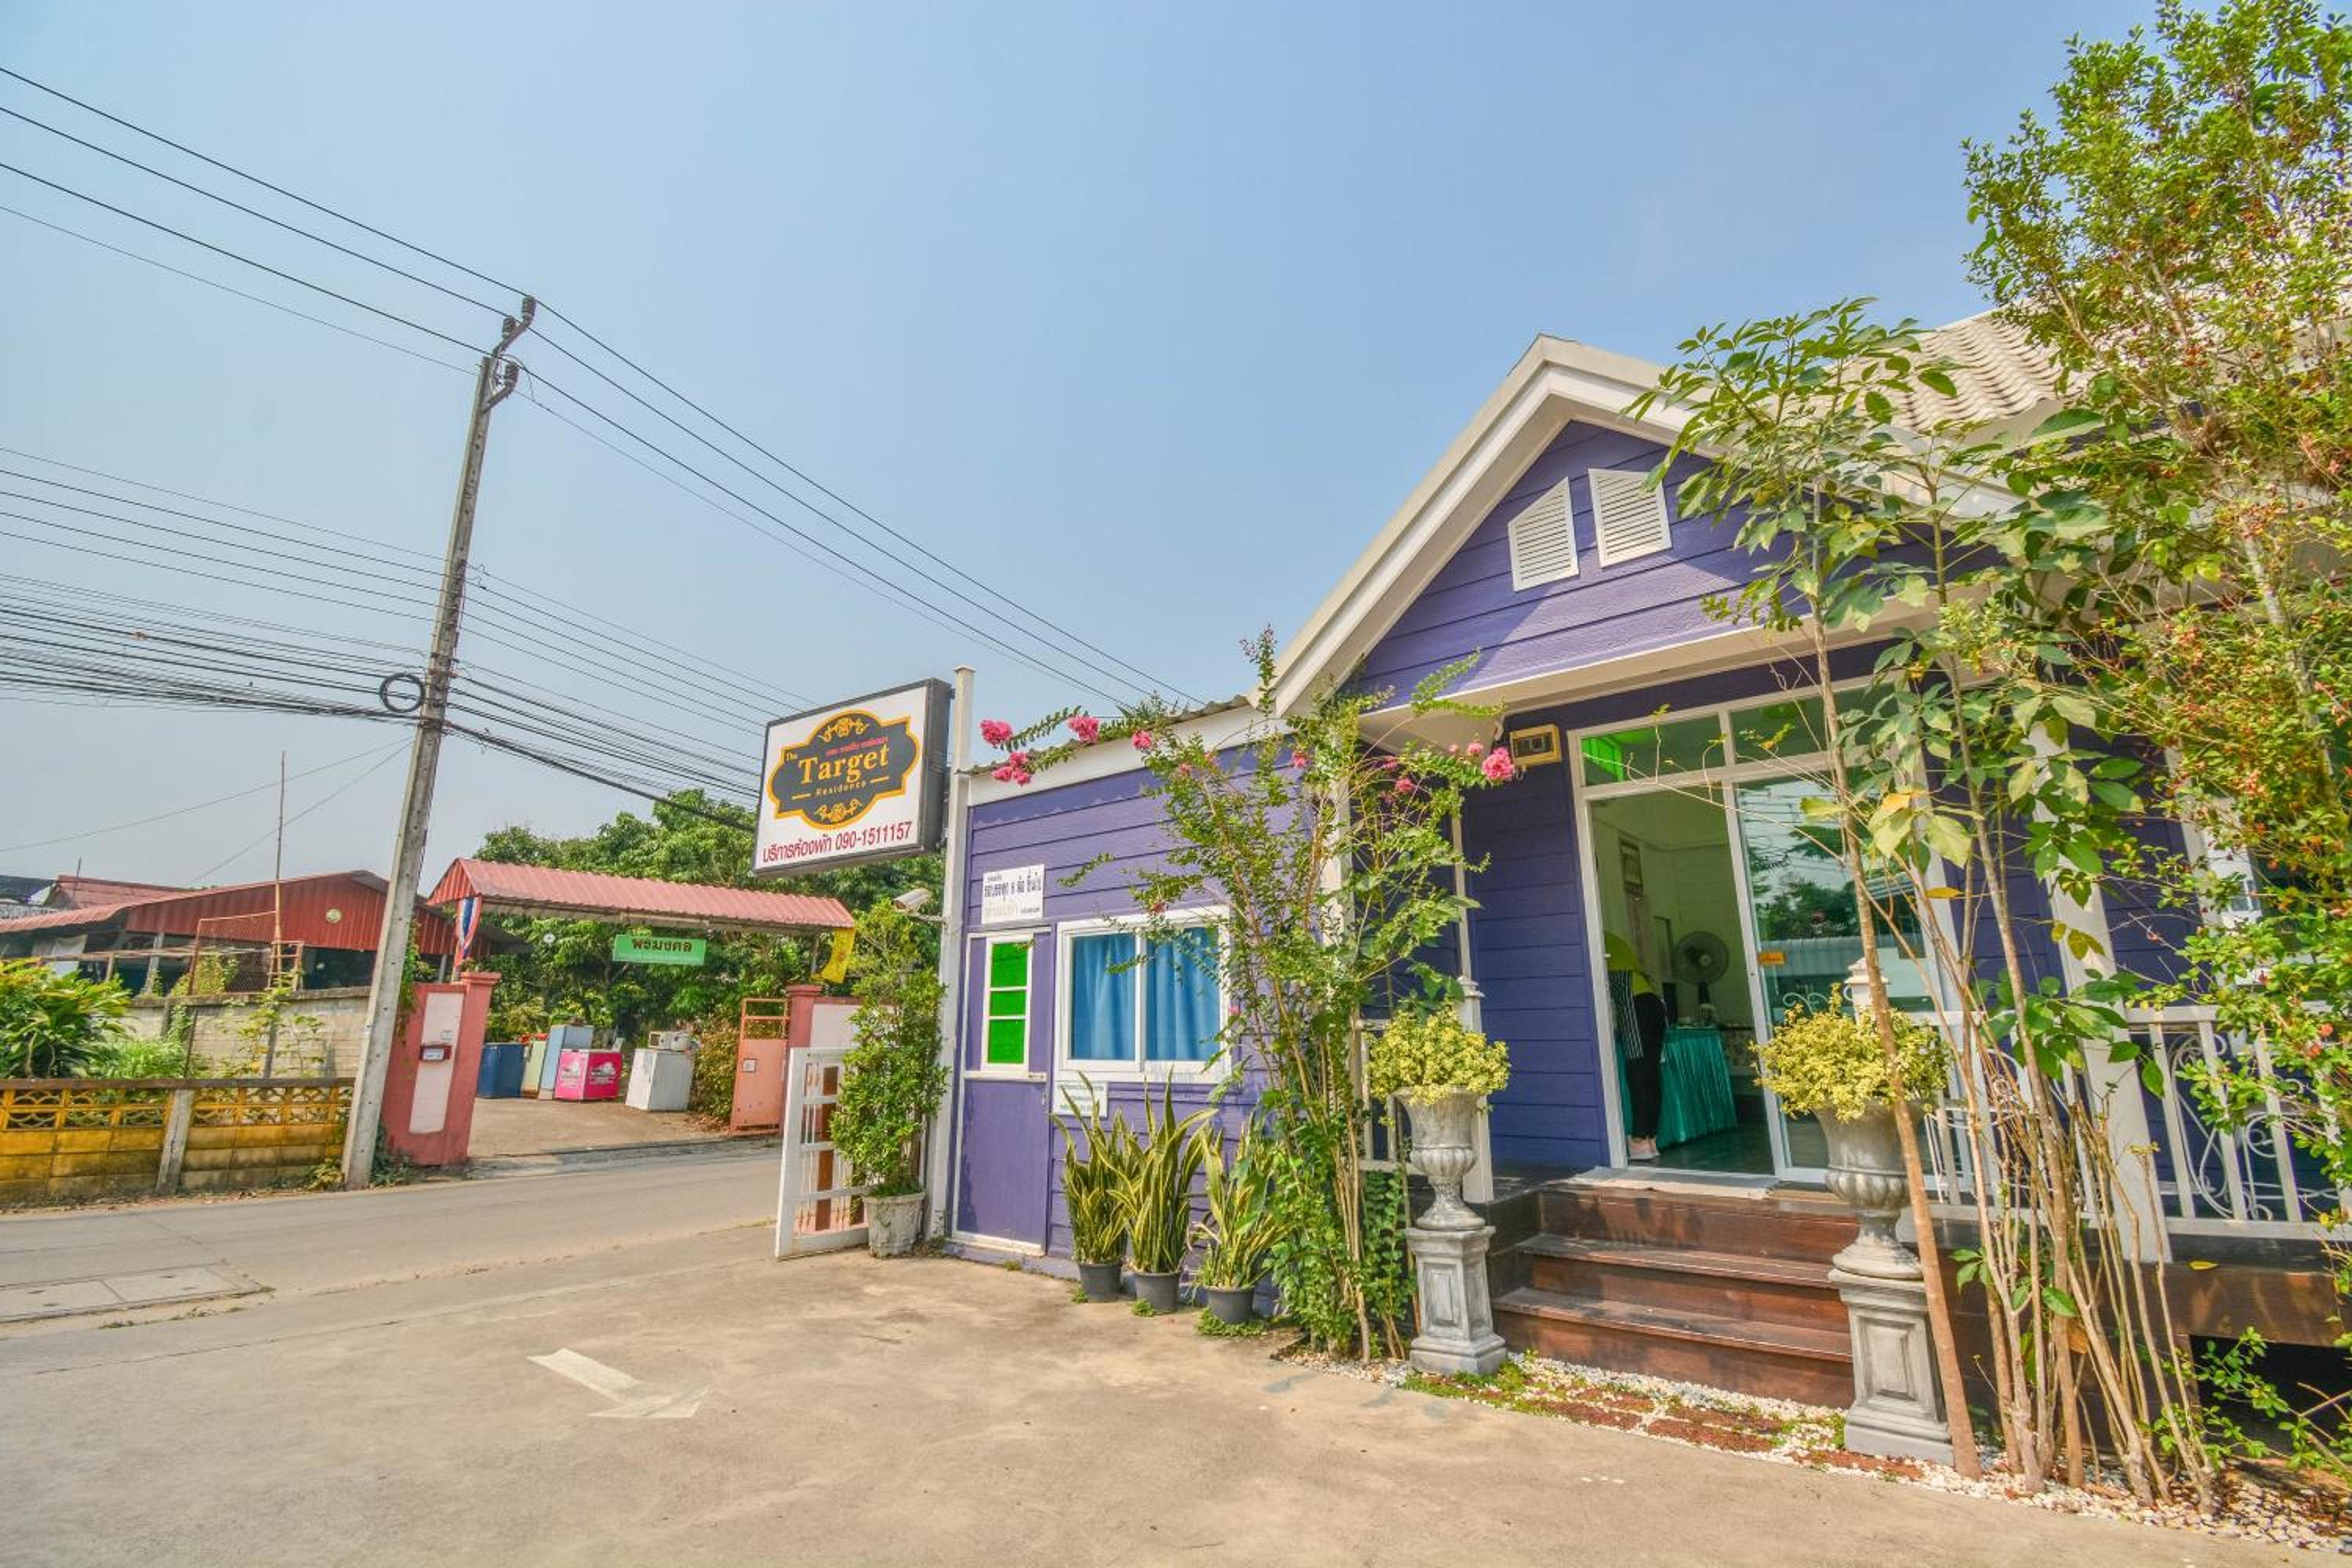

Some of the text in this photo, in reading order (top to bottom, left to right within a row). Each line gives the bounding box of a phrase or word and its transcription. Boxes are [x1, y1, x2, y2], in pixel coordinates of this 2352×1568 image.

[798, 743, 890, 784] Target
[815, 780, 866, 796] Residence
[763, 822, 912, 862] บริการห้องพัก 090-1511157
